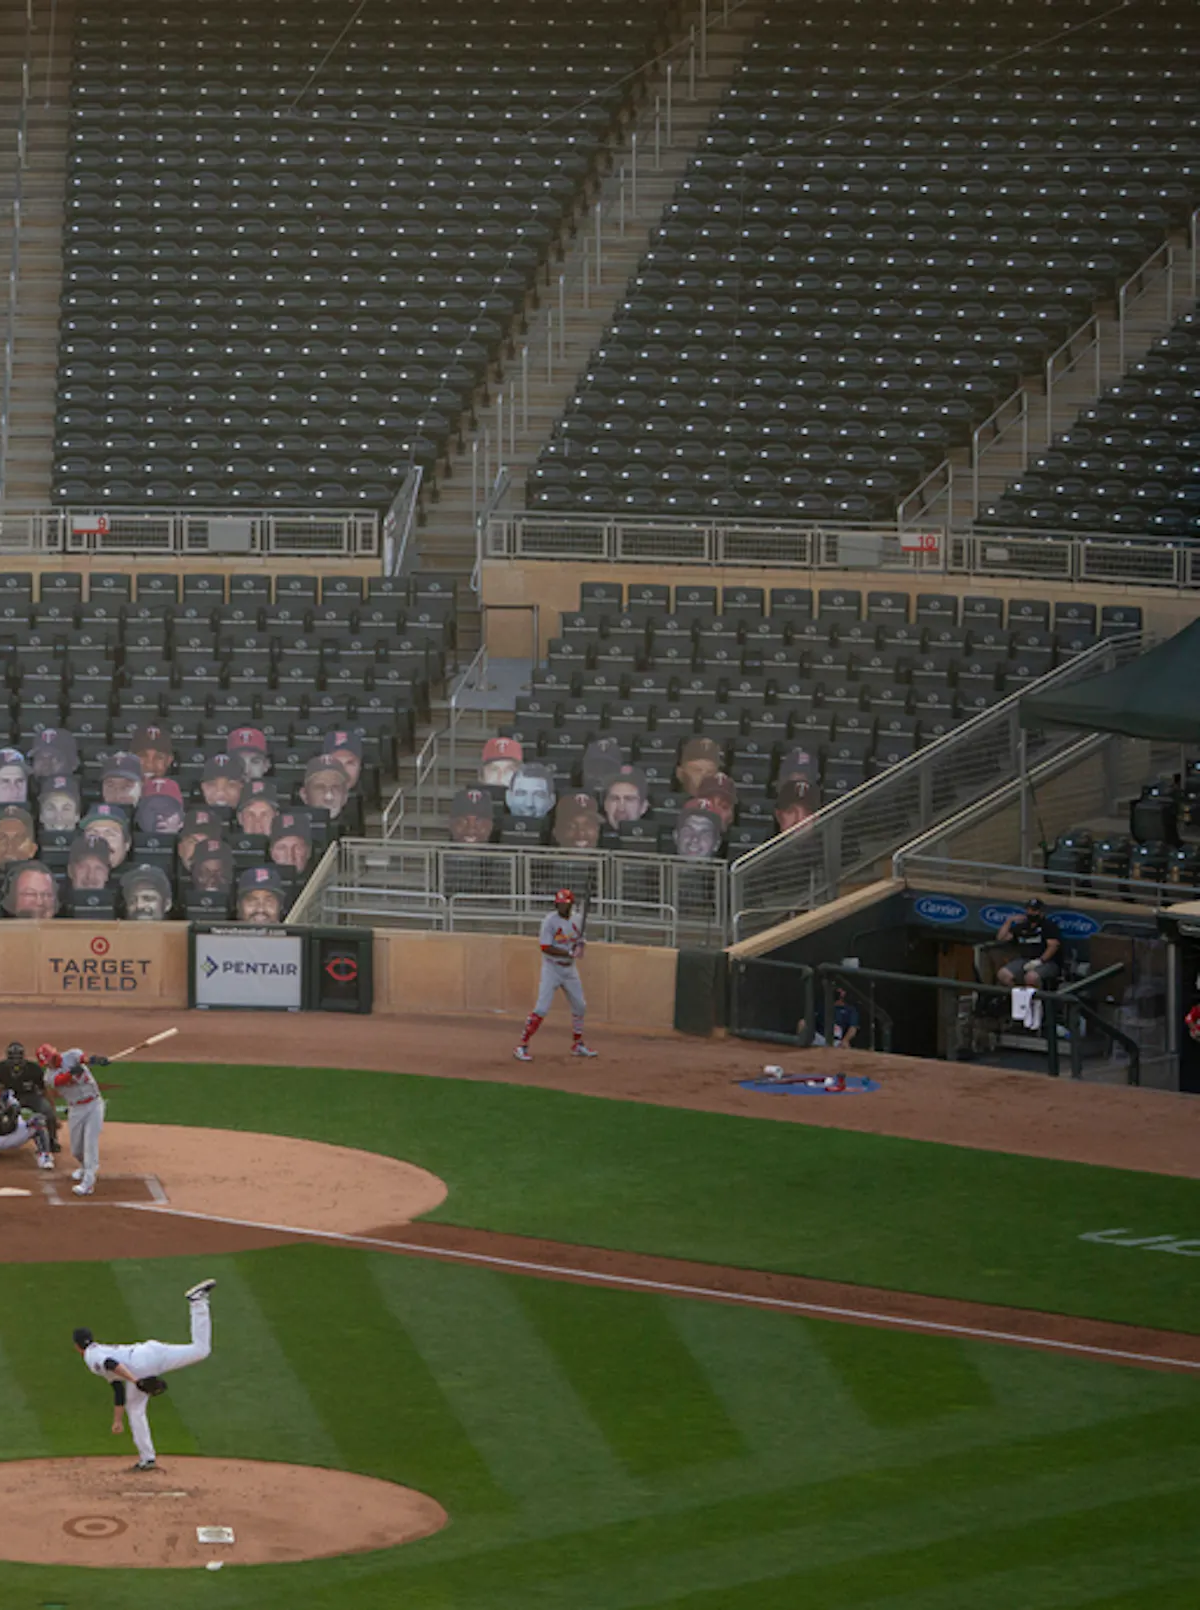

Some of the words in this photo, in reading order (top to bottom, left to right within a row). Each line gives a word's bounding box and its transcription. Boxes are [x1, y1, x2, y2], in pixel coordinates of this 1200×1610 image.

[917, 533, 936, 549] 10
[919, 900, 962, 917] Carrier
[49, 958, 152, 975] TARGET
[222, 961, 298, 976] PENTAIR
[63, 975, 137, 991] FIELD
